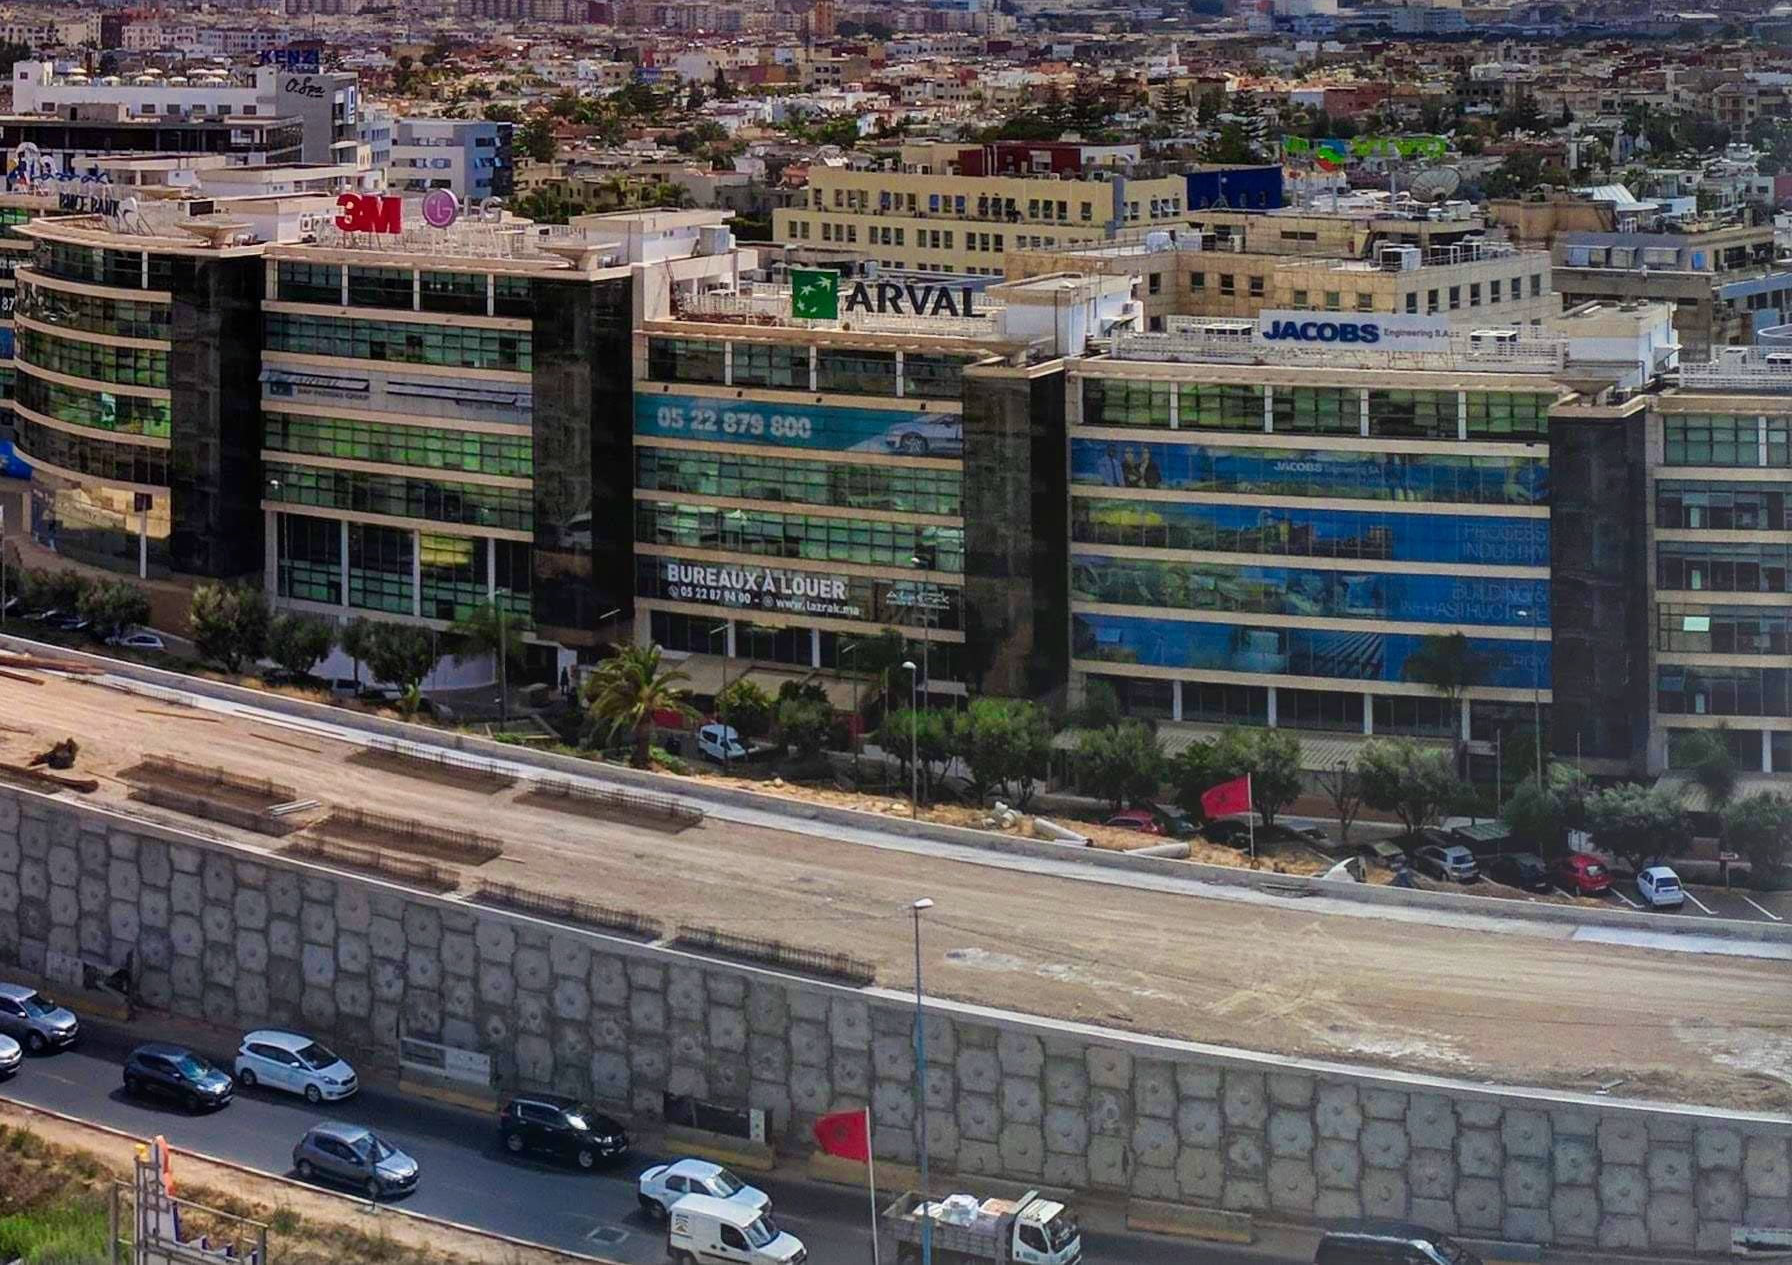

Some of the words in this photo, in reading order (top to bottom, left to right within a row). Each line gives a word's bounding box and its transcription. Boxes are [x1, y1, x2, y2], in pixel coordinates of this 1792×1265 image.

[335, 192, 403, 234] 3M
[845, 281, 986, 318] ARVAL
[1263, 320, 1380, 343] JACOBS
[1383, 327, 1434, 339] Engineering
[657, 406, 684, 429] 05
[690, 408, 718, 431] 22
[723, 412, 765, 434] 879
[770, 415, 812, 438] 800
[667, 563, 760, 591] BUREAUX
[762, 568, 777, 593] À
[780, 575, 846, 600] LOUER
[680, 585, 693, 598] 05
[695, 587, 708, 599] 22
